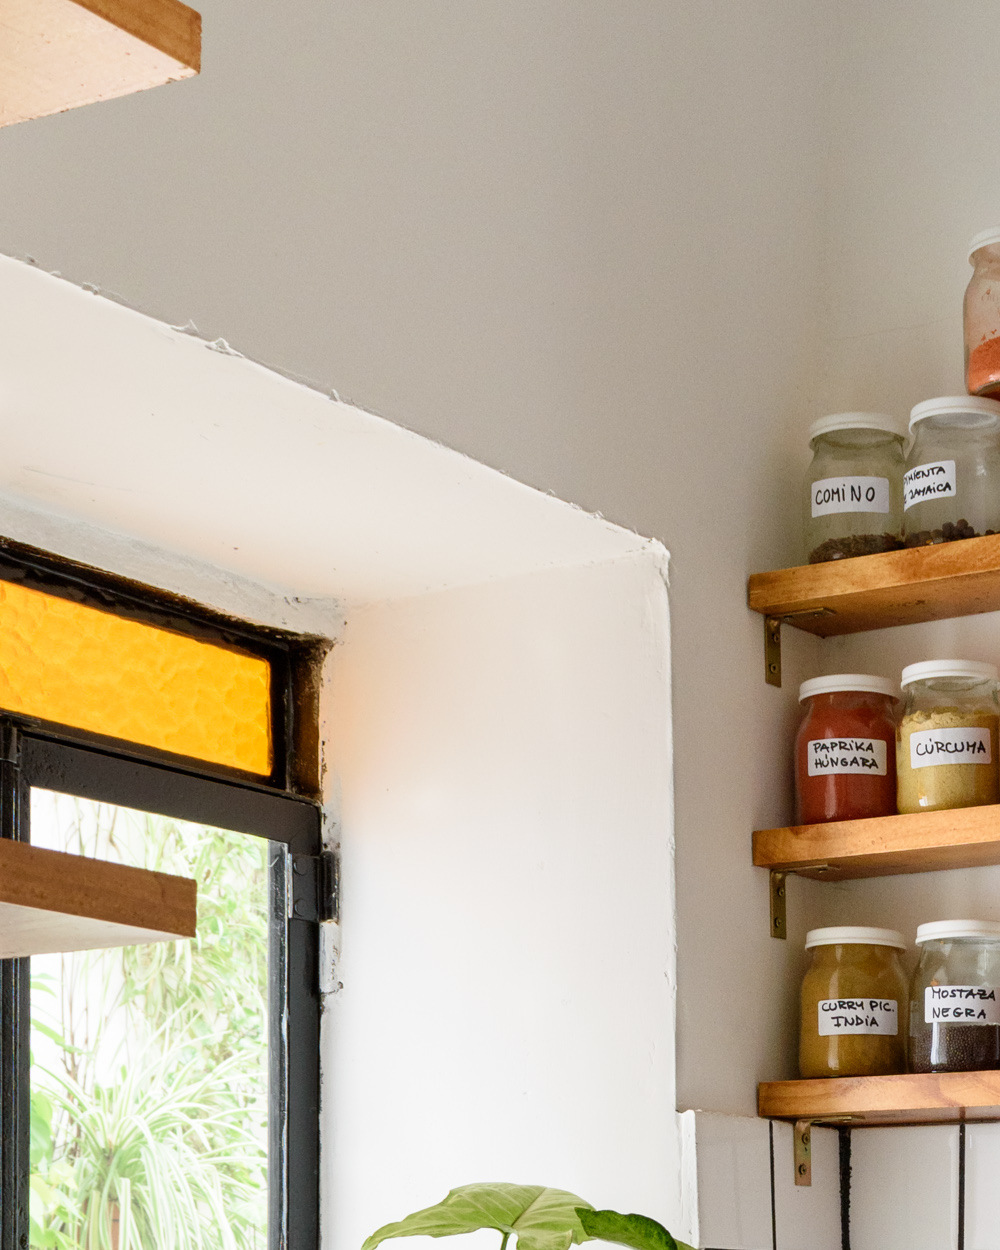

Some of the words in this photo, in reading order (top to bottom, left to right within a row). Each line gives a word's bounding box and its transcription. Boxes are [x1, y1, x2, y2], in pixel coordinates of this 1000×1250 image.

[815, 484, 876, 505] COMINO
[812, 740, 875, 754] PAPRIKA
[931, 987, 996, 1001] MOSTAZA
[821, 1001, 865, 1013] CURRY
[869, 1000, 896, 1013] PIC.
[932, 1007, 988, 1020] NEGRA
[830, 1014, 880, 1028] INDIA
